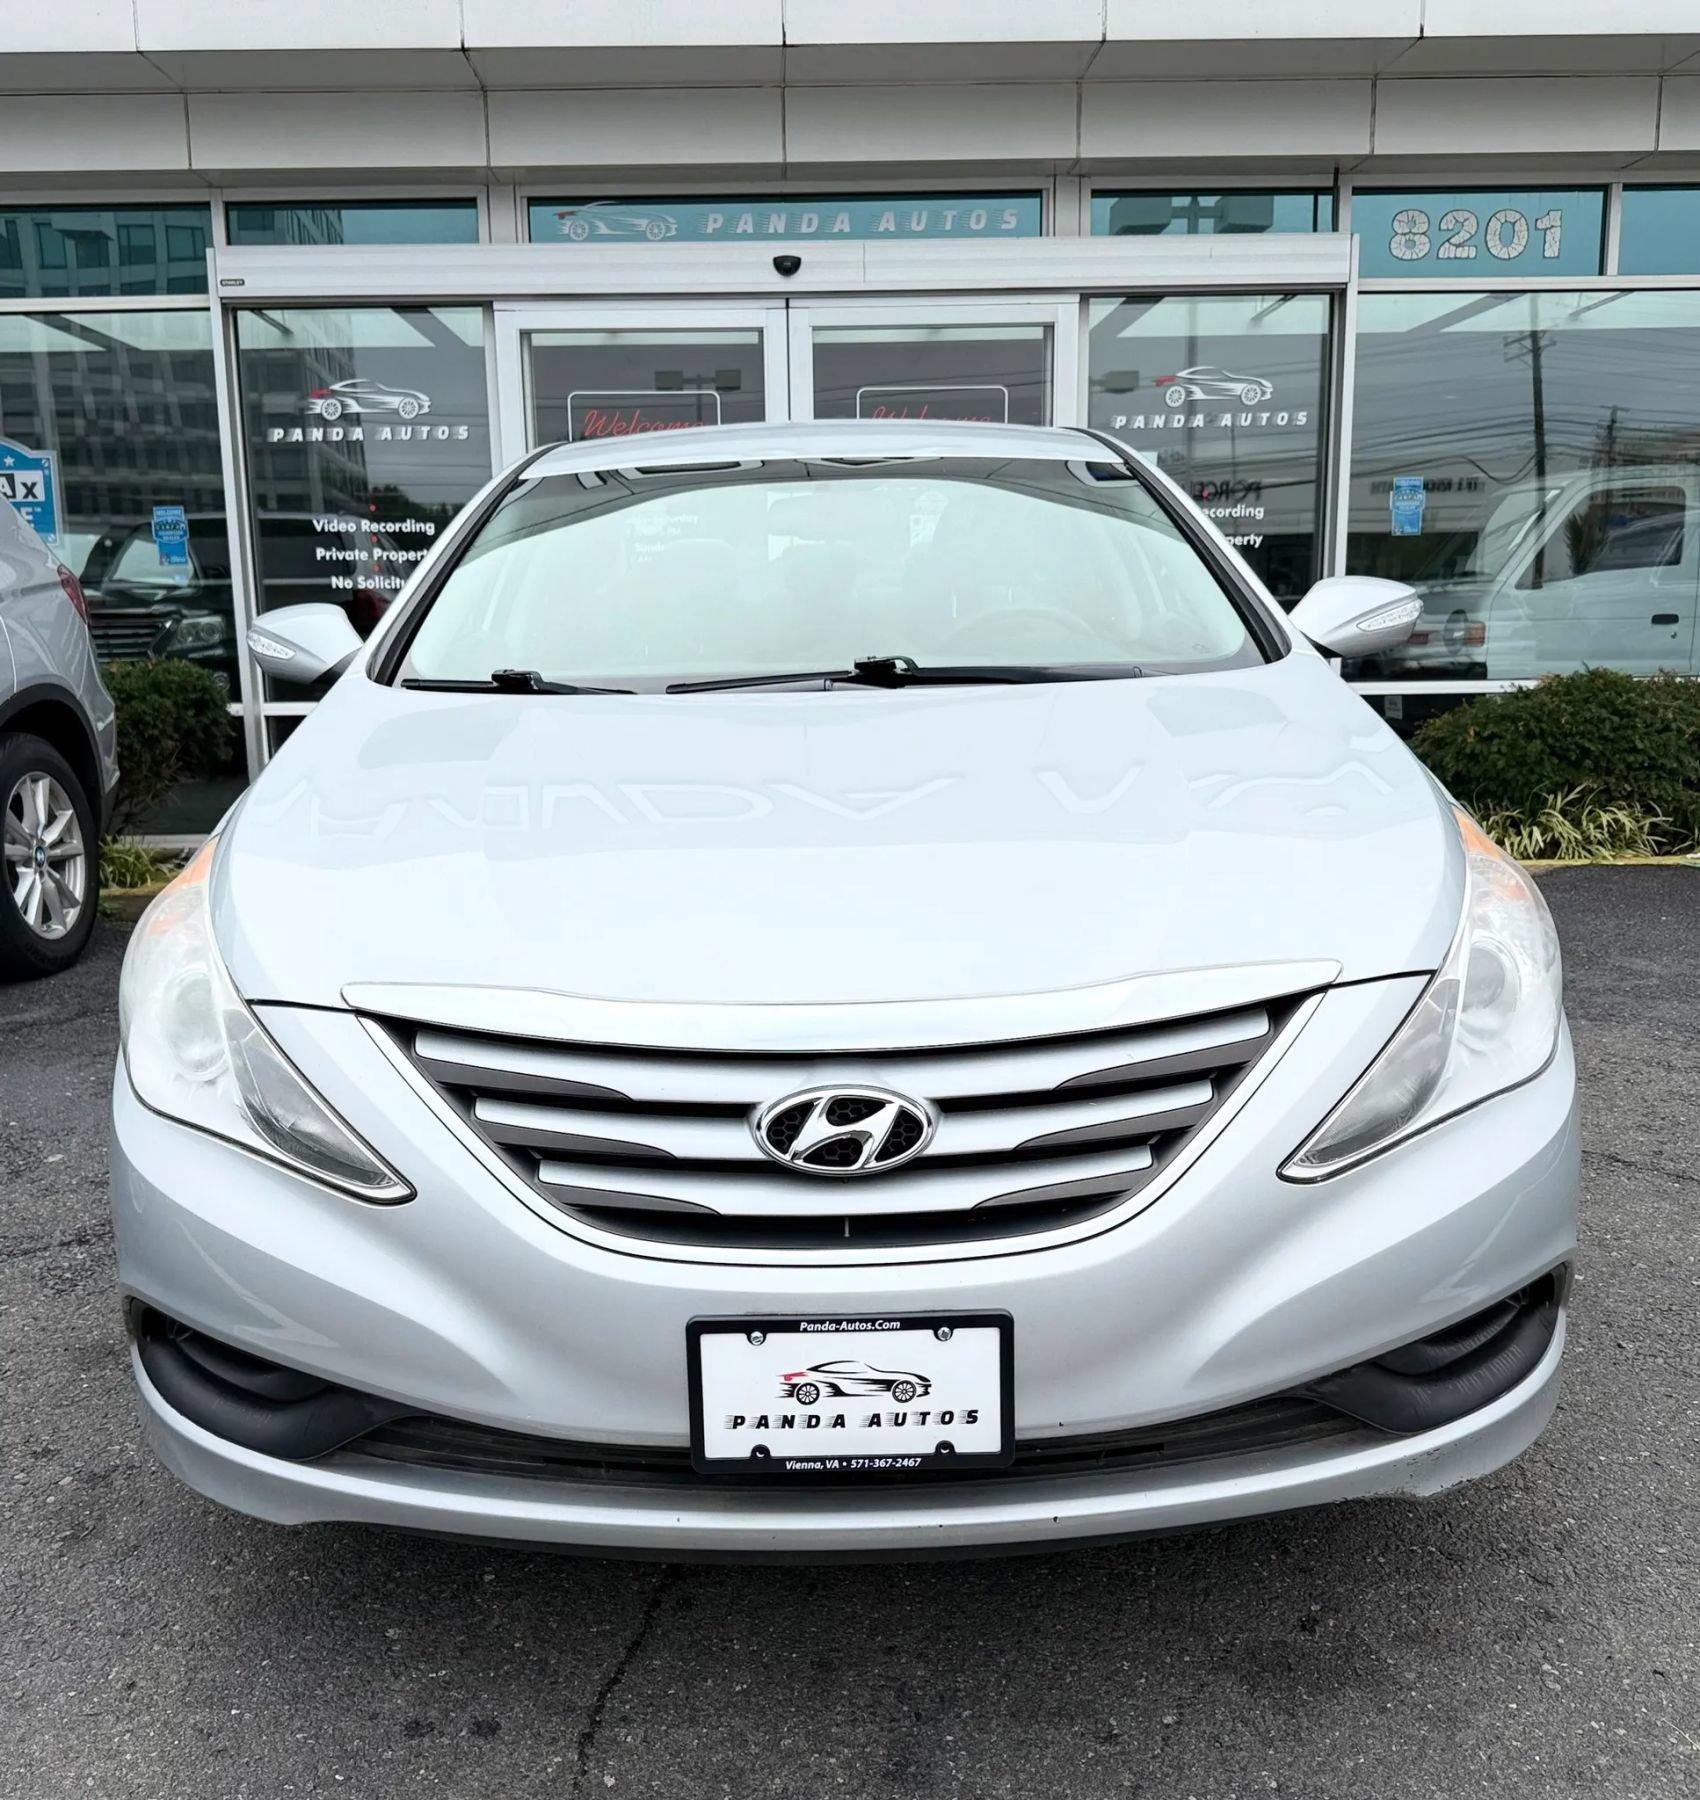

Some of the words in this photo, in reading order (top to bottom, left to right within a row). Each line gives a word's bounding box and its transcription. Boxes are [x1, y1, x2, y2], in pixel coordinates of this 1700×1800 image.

[701, 212, 851, 233] PANDA
[872, 209, 1018, 232] AUTOS
[1388, 208, 1563, 261] 8201
[1111, 413, 1205, 430] PANDA
[1216, 411, 1308, 427] AUTOS
[268, 427, 365, 443] PANDA
[376, 425, 470, 441] AUTOS
[312, 518, 357, 533] Video
[361, 518, 436, 536] Recording
[316, 546, 369, 561] Private
[330, 575, 354, 589] No
[357, 575, 406, 590] Solicit
[799, 1319, 901, 1332] Panda-Autos.Com
[724, 1414, 846, 1430] PANDA
[864, 1409, 980, 1429] AUTOS
[785, 1460, 824, 1470] Vienna,
[825, 1459, 840, 1469] VA
[850, 1457, 922, 1469] 571-367-2467
